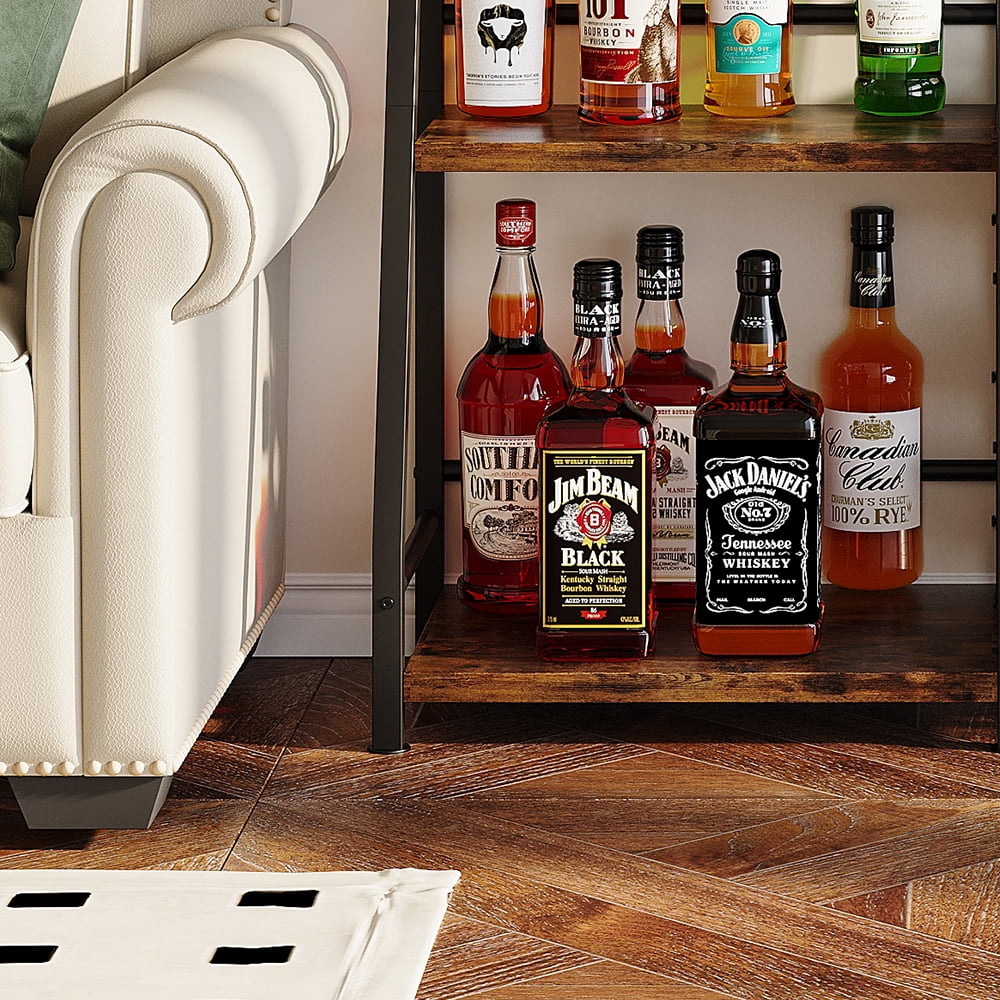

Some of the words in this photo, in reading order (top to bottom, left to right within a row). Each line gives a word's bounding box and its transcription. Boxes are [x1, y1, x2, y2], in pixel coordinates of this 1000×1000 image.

[583, 26, 635, 38] BOURBON
[638, 268, 681, 279] BLACK
[859, 283, 888, 297] Club
[575, 303, 620, 315] BLACK
[825, 427, 919, 460] Canadian
[465, 446, 538, 473] SOUTH
[704, 467, 747, 499] JACK
[746, 461, 812, 499] DANIEL'S
[838, 460, 907, 492] Club
[548, 475, 585, 514] JIM
[586, 468, 640, 515] BEAM
[658, 497, 697, 508] STRAIGHT
[831, 494, 875, 507] CHAIRMAN'S
[878, 495, 907, 506] SELECT
[659, 508, 691, 519] WHISKEY
[740, 507, 772, 518] No.7
[831, 504, 870, 525] 100%
[873, 506, 907, 525] RYE
[589, 512, 600, 527] B
[721, 534, 792, 550] Tennessee
[560, 547, 626, 567] BLACK
[722, 558, 791, 569] WHISKEY
[560, 575, 595, 585] Kentucky
[597, 575, 627, 585] Straight
[560, 584, 593, 592] Bourbon
[596, 584, 627, 594] Whiskey
